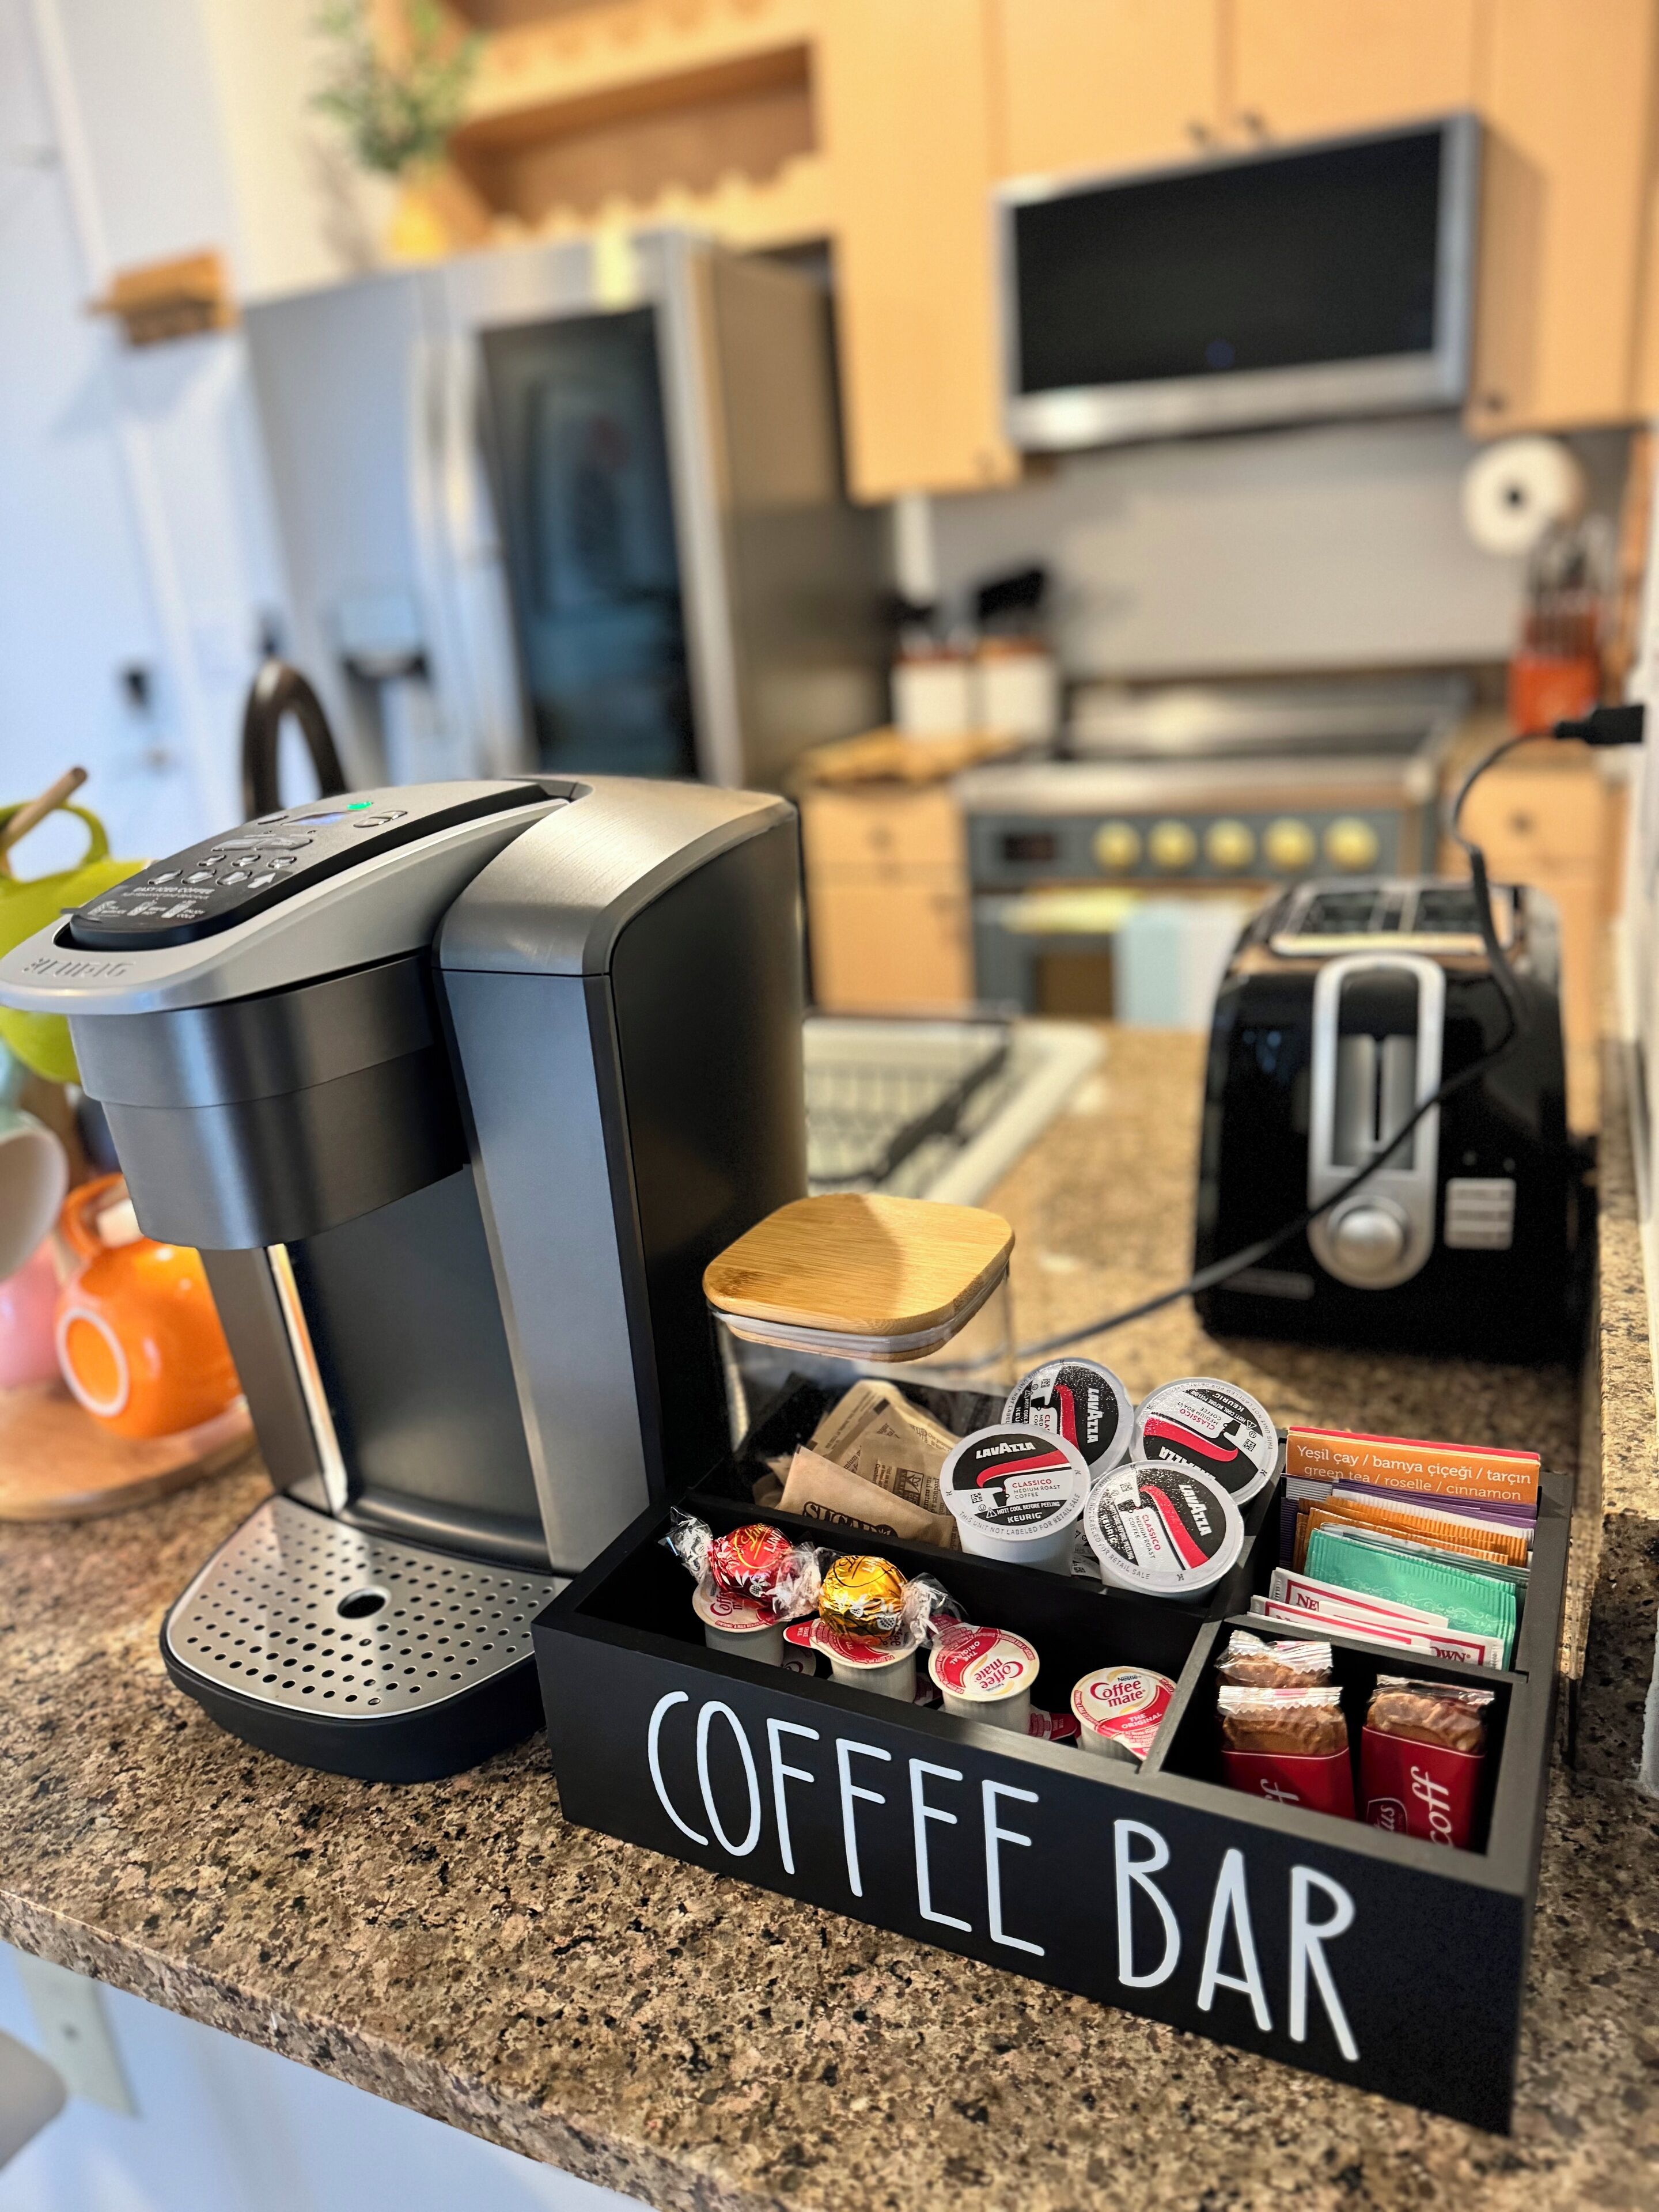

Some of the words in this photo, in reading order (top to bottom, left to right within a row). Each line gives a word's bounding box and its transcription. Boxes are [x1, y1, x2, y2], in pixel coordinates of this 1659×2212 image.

[1009, 1392, 1019, 1405] NOT
[1213, 1393, 1245, 1412] KEURIG
[1005, 1405, 1014, 1424] LABEL
[1086, 1387, 1103, 1444] LAVAZZA
[1179, 1408, 1215, 1430] CLASSICO
[1195, 1412, 1219, 1425] MEDIUM
[1200, 1407, 1222, 1421] COFFEE
[1222, 1407, 1235, 1418] COOL
[1234, 1414, 1247, 1423] HOT!
[975, 1442, 1036, 1459] LAVAZZA
[1297, 1445, 1329, 1461] Yeşil
[1333, 1453, 1359, 1467] çay
[1362, 1454, 1369, 1466] /
[1372, 1455, 1423, 1474] bamya
[1427, 1463, 1472, 1480] çiçeği
[1475, 1467, 1483, 1480] /
[1486, 1469, 1531, 1486] tarçın
[1012, 1479, 1052, 1488] CLASSICO
[1013, 1486, 1039, 1494] MEDIUM
[1304, 1467, 1344, 1480] green
[1349, 1471, 1370, 1483] tea
[1374, 1474, 1381, 1484] /
[1384, 1476, 1432, 1491] roselle
[1435, 1481, 1442, 1493] /
[1446, 1483, 1521, 1501] cinnamon
[803, 1501, 876, 1533] SUG
[959, 1511, 973, 1524] THIS
[973, 1520, 988, 1532] UNIT
[990, 1527, 1004, 1535] NOT
[1006, 1526, 1038, 1535] LABELED
[1039, 1521, 1053, 1531] FOR
[1054, 1506, 1072, 1524] RETAIL
[1070, 1493, 1081, 1509] SALE
[1007, 1512, 1043, 1524] KEURIG
[1179, 1484, 1213, 1536] LAVAZZA
[1101, 1514, 1118, 1544] KEURIG
[1128, 1517, 1141, 1539] COFFEE
[1134, 1515, 1147, 1539] MEDIUM
[1144, 1539, 1156, 1559] ROAST
[1142, 1514, 1161, 1551] CLASSICO
[1108, 1554, 1130, 1573] RETAIL
[1131, 1569, 1150, 1580] SALE
[979, 1661, 1024, 1689] Coffee
[1090, 1680, 1142, 1700] Coffee
[1121, 1712, 1163, 1729] ORIGINAL
[1128, 1713, 1147, 1722] THE
[1410, 1766, 1453, 1847] coff
[647, 1690, 1045, 1956] COFFEE
[1113, 1819, 1360, 2062] BAR
